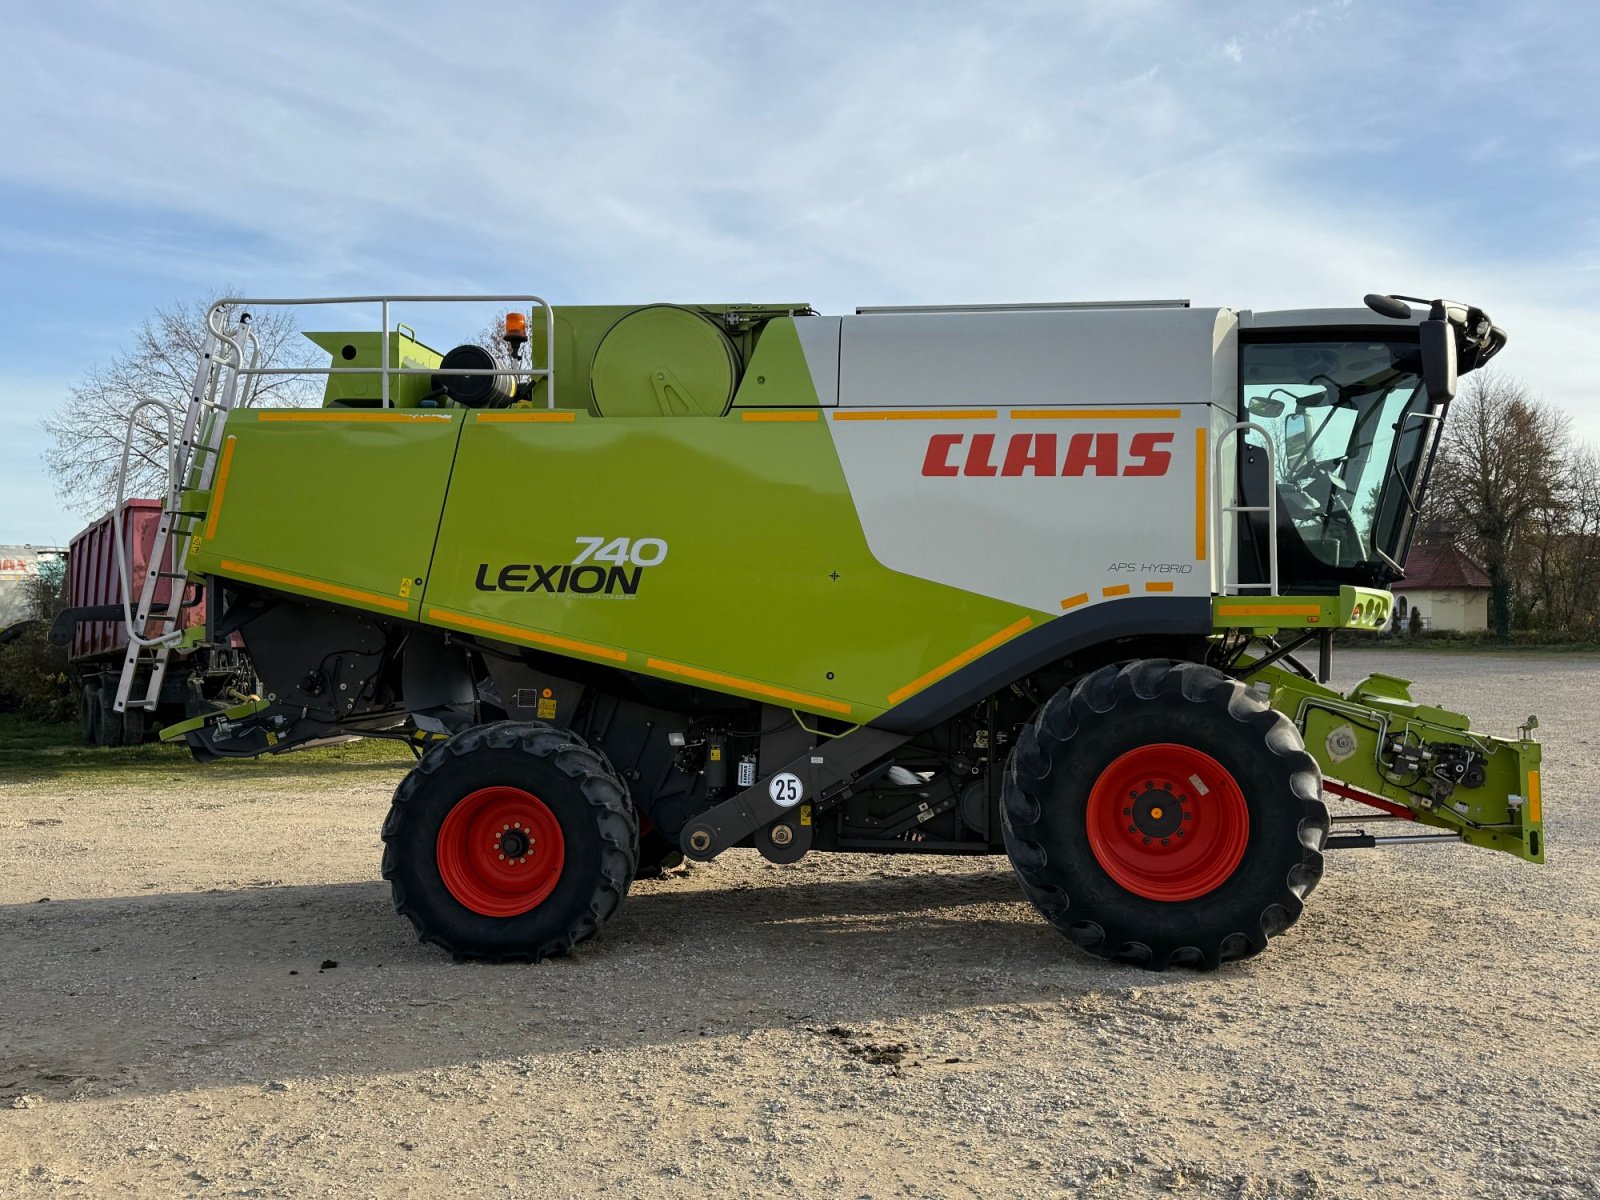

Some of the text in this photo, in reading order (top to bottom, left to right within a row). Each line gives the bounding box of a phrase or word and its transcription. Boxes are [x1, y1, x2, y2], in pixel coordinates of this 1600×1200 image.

[921, 432, 1175, 477] CLAAS
[570, 536, 668, 567] 740
[475, 563, 644, 594] LEXION
[1108, 562, 1193, 574] APS HYBRID
[776, 779, 796, 801] 25
